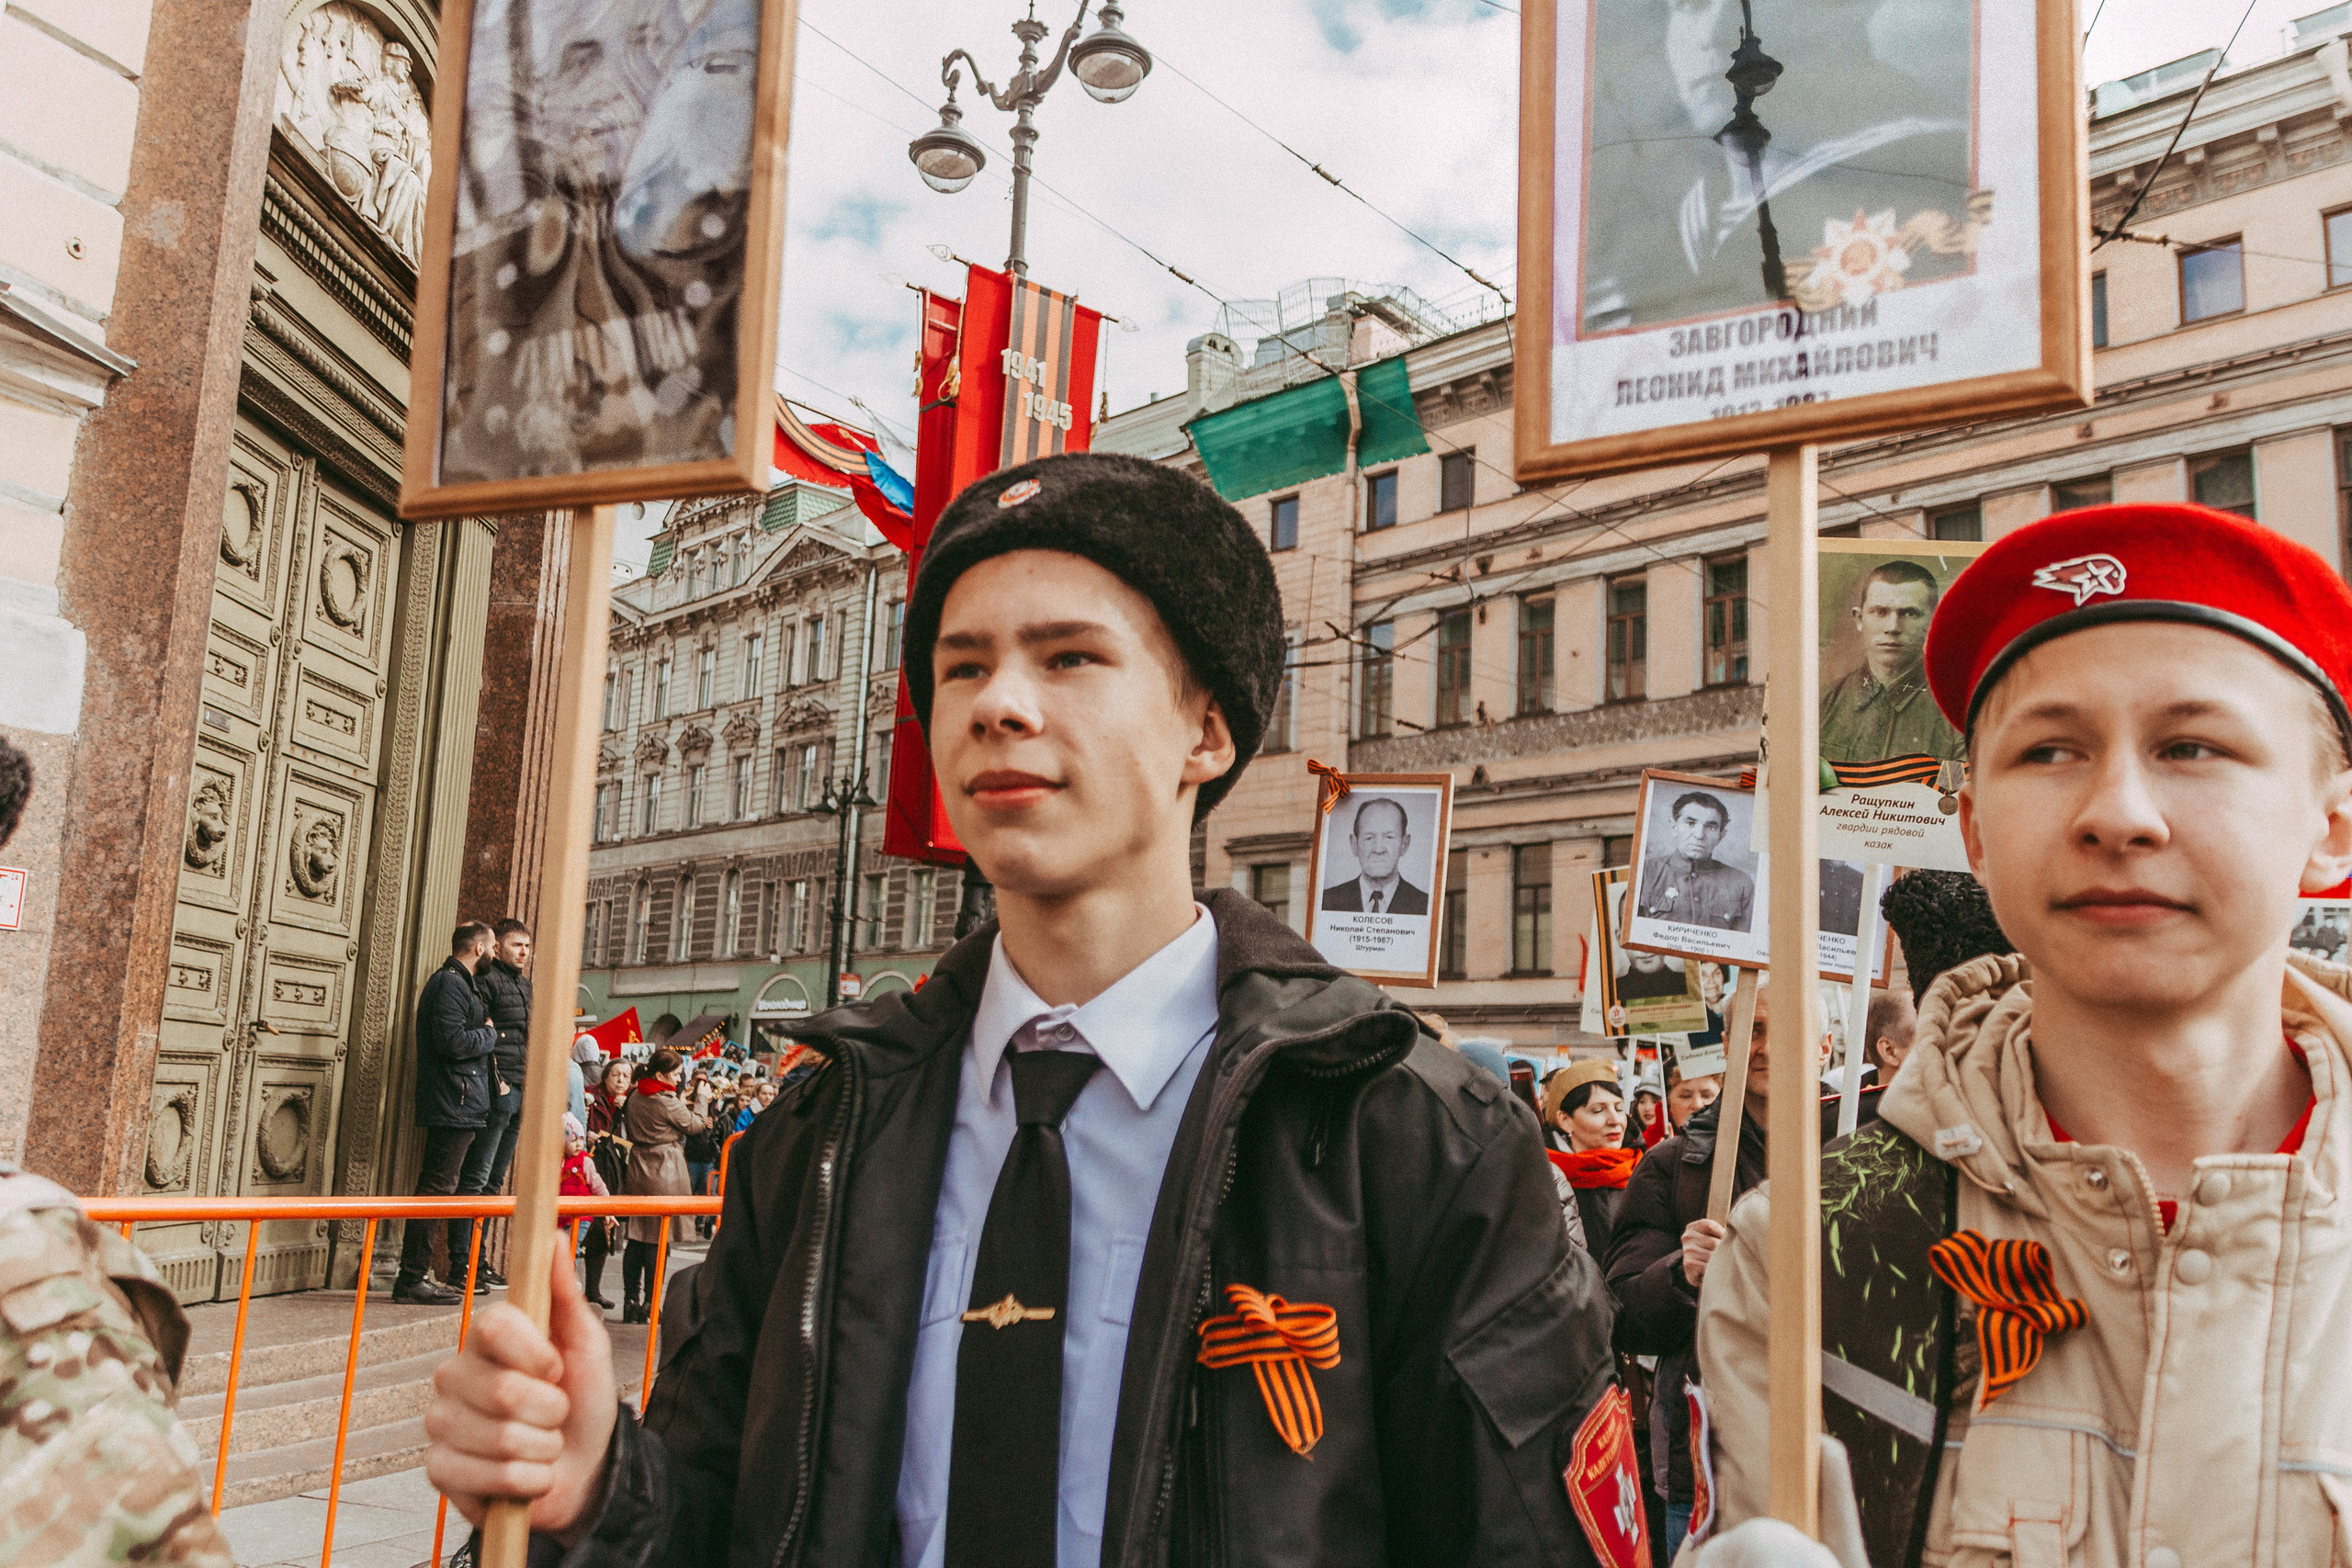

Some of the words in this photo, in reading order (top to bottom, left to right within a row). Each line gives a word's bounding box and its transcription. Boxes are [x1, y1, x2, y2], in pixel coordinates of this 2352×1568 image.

[1001, 347, 1046, 388] 1941
[1615, 366, 1725, 407] ЛЕОНИД
[1733, 332, 1939, 389] МИХАЙЛОВИЧ
[1023, 391, 1073, 431] 1945
[1850, 794, 1916, 809] Ращупкин
[1819, 805, 1870, 819] Алексей
[1872, 809, 1946, 826] Никитович
[1837, 823, 1879, 833] гвардии
[1881, 826, 1925, 838] рядовой
[1864, 840, 1894, 850] казак
[1352, 916, 1393, 924] КОЛЕСОВ
[1329, 924, 1364, 932] Николай
[1366, 926, 1415, 935] Степанович
[1668, 925, 1718, 939] КИРИЧЕНКО
[1349, 935, 1394, 945] (1915-1987)
[1653, 931, 1680, 943] Федор
[1681, 936, 1731, 950] Васильевич
